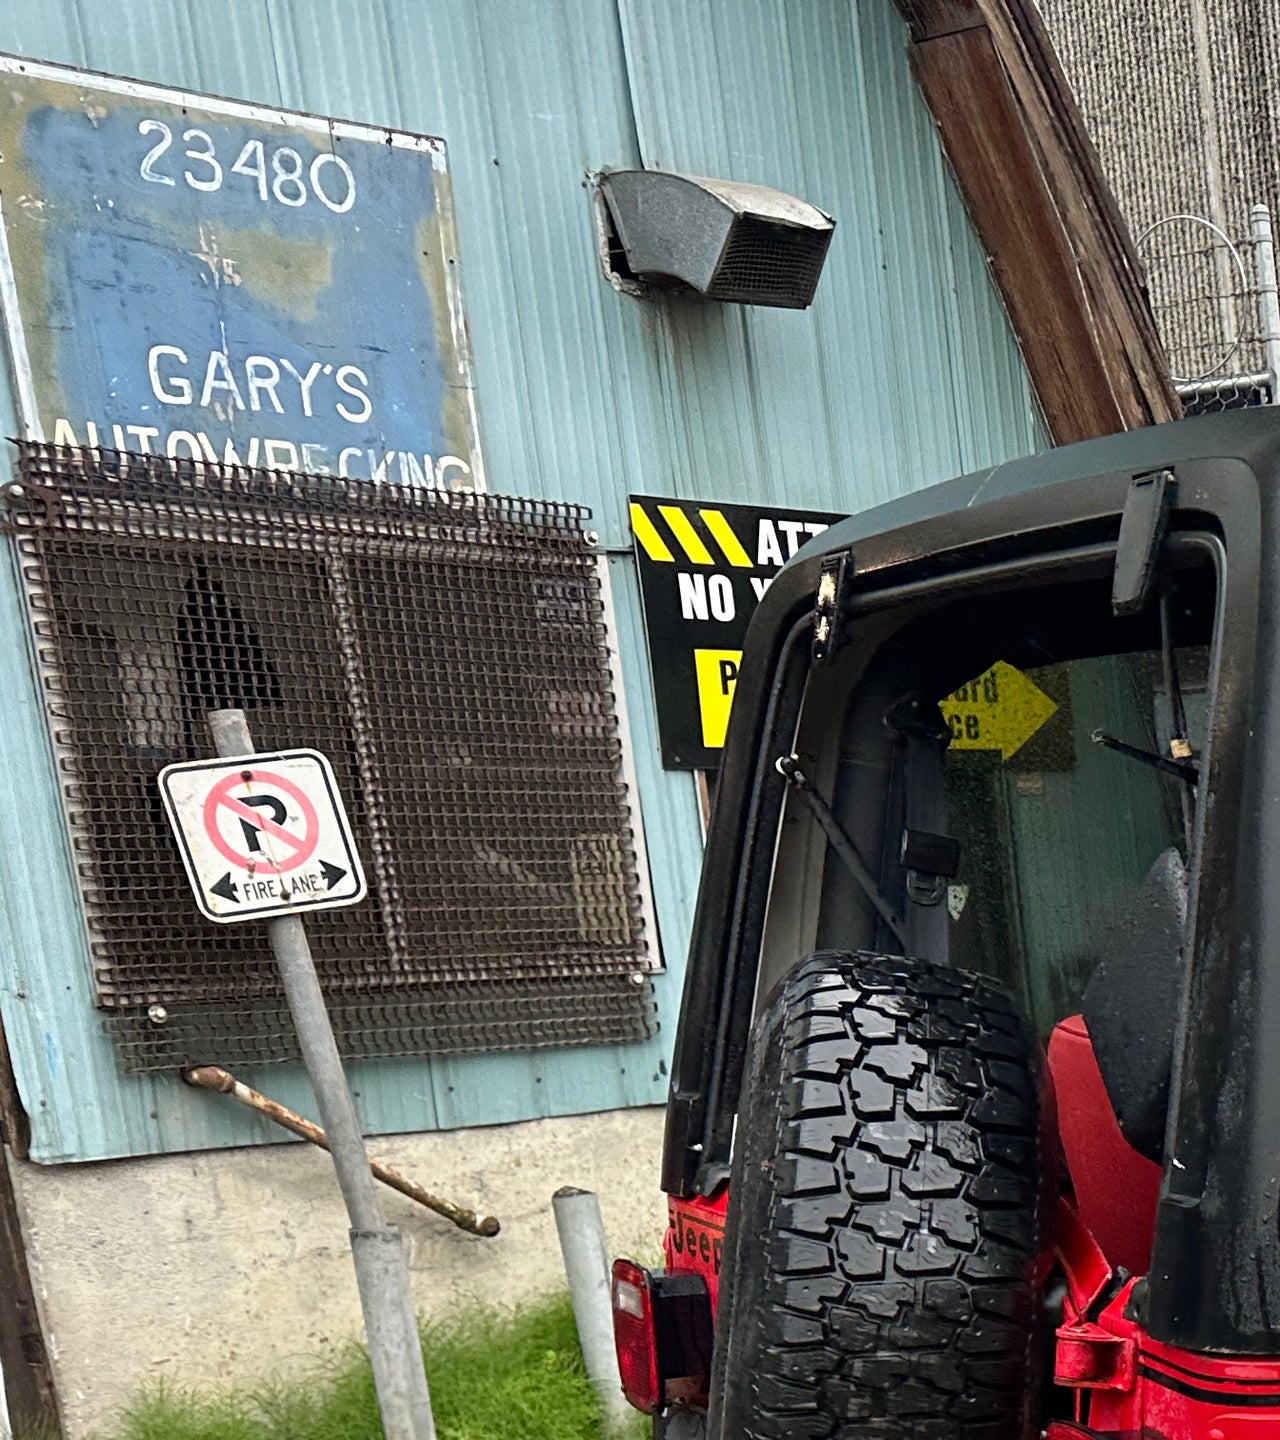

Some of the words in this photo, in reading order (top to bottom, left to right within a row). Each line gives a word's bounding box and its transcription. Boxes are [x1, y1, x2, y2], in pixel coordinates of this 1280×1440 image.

[138, 119, 356, 214] 23480
[147, 344, 373, 424] GARY'S
[677, 572, 736, 622] NO
[243, 879, 279, 901] FIRE
